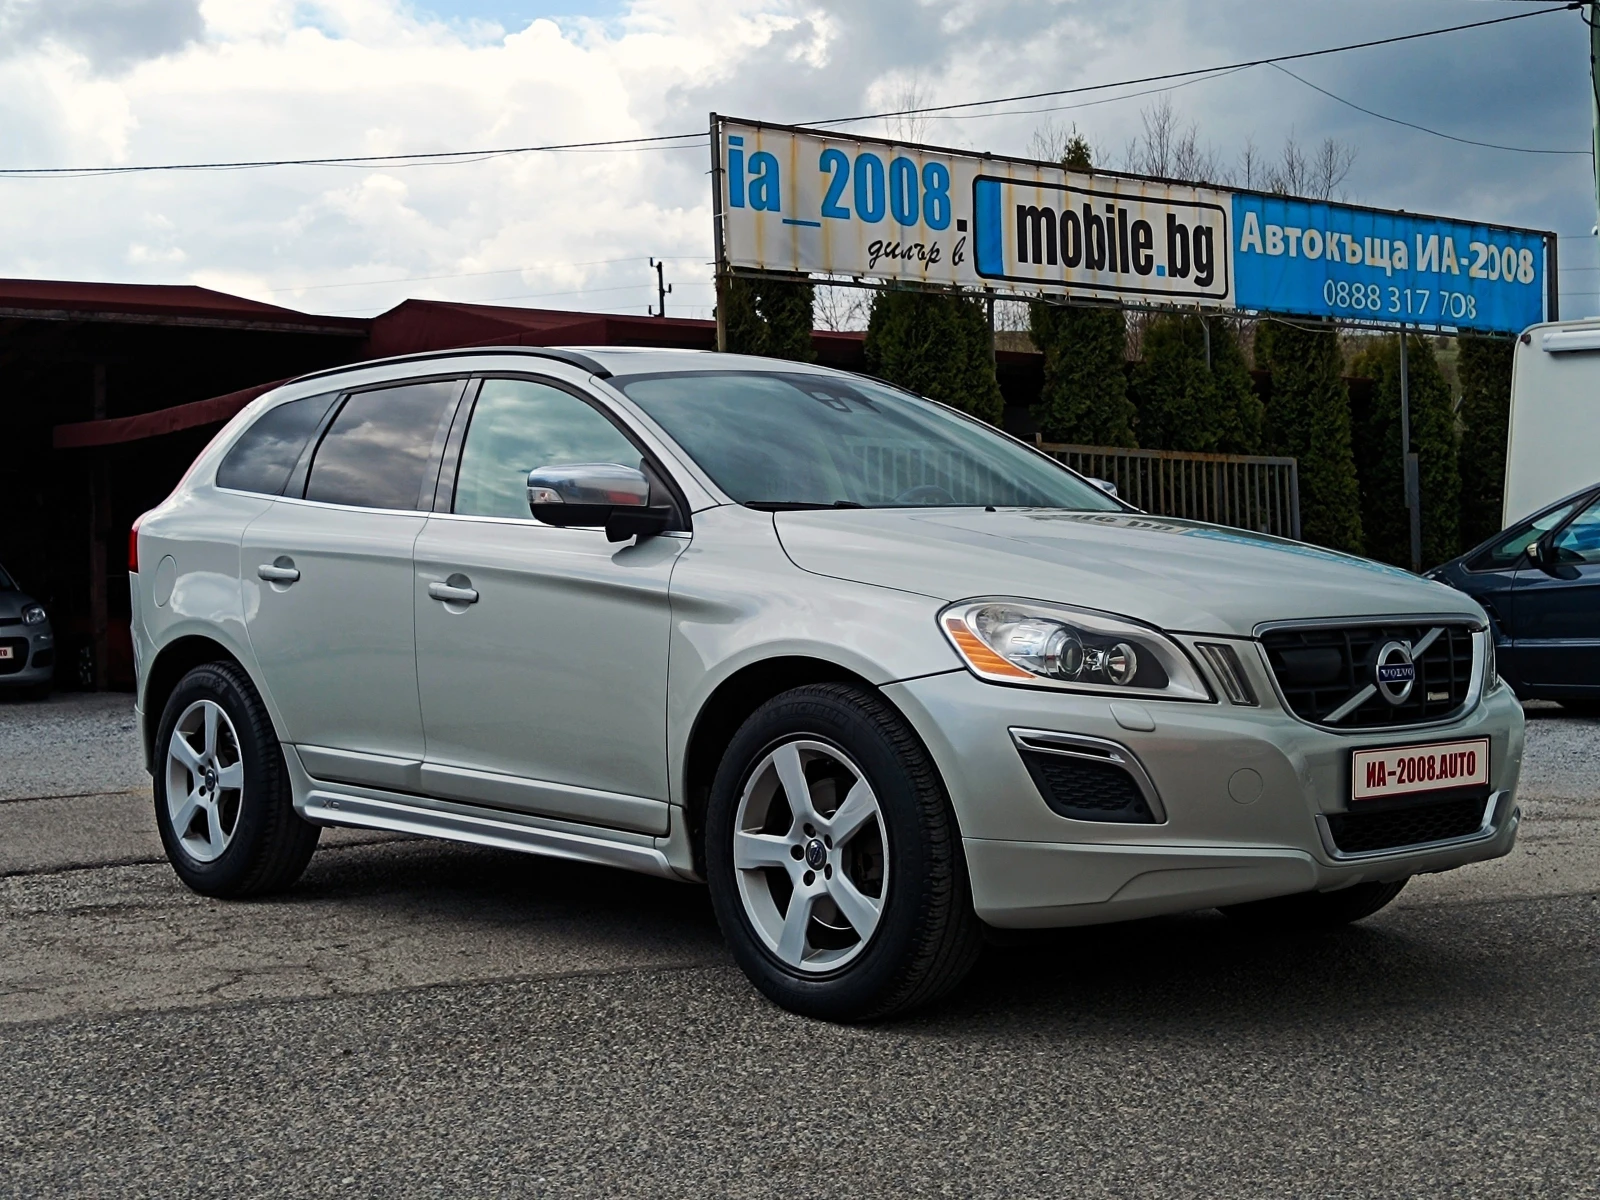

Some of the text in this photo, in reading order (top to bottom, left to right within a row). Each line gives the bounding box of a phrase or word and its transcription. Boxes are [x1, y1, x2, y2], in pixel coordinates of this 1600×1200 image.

[1016, 203, 1214, 287] mobile.bg
[1240, 211, 1535, 285] Автокъща ИА-2008
[1323, 279, 1477, 320] 0888 317 708
[1381, 667, 1413, 679] VOLVO
